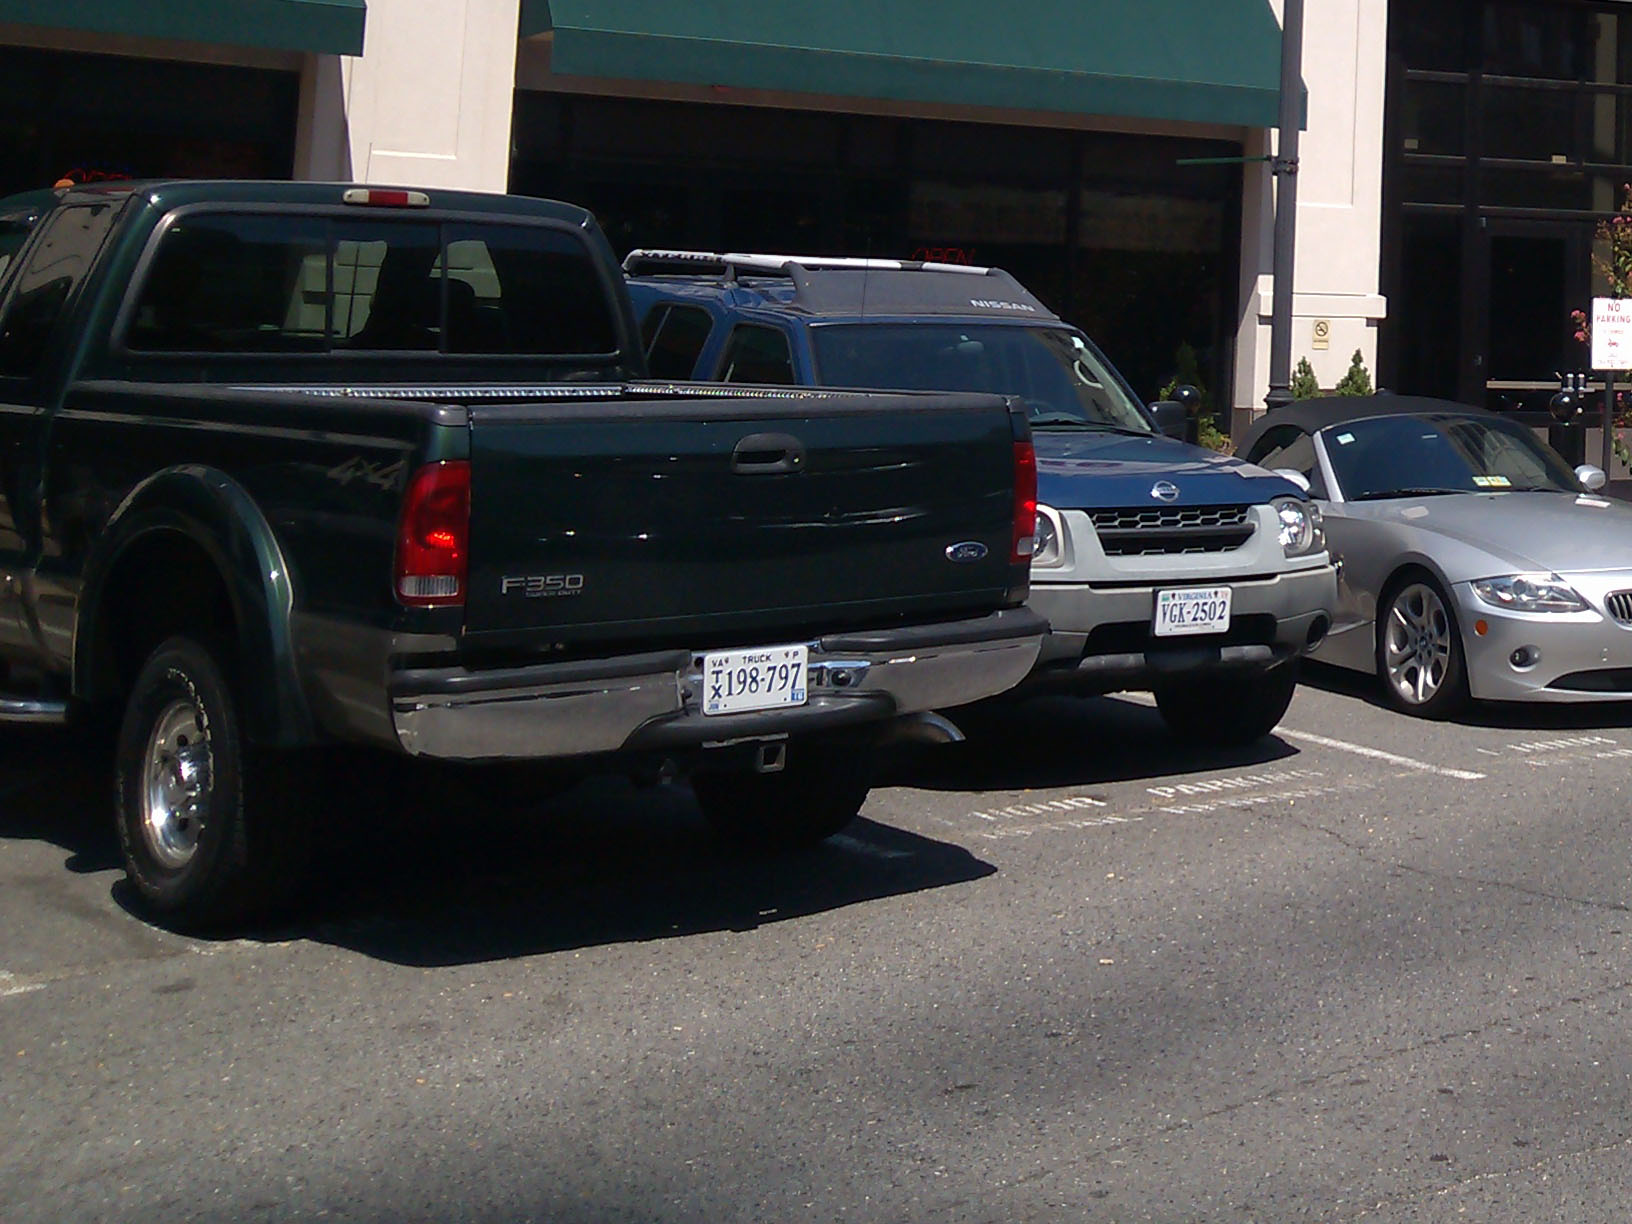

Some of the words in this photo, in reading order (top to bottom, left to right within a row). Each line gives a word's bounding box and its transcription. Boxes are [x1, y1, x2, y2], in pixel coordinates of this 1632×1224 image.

[970, 299, 1036, 312] NISSAN
[1607, 303, 1621, 313] NO
[1596, 314, 1632, 324] PARKING
[1161, 600, 1227, 625] VGK-2502
[711, 659, 724, 668] VA
[742, 653, 772, 665] TRUCK
[972, 795, 1108, 822] HOUR
